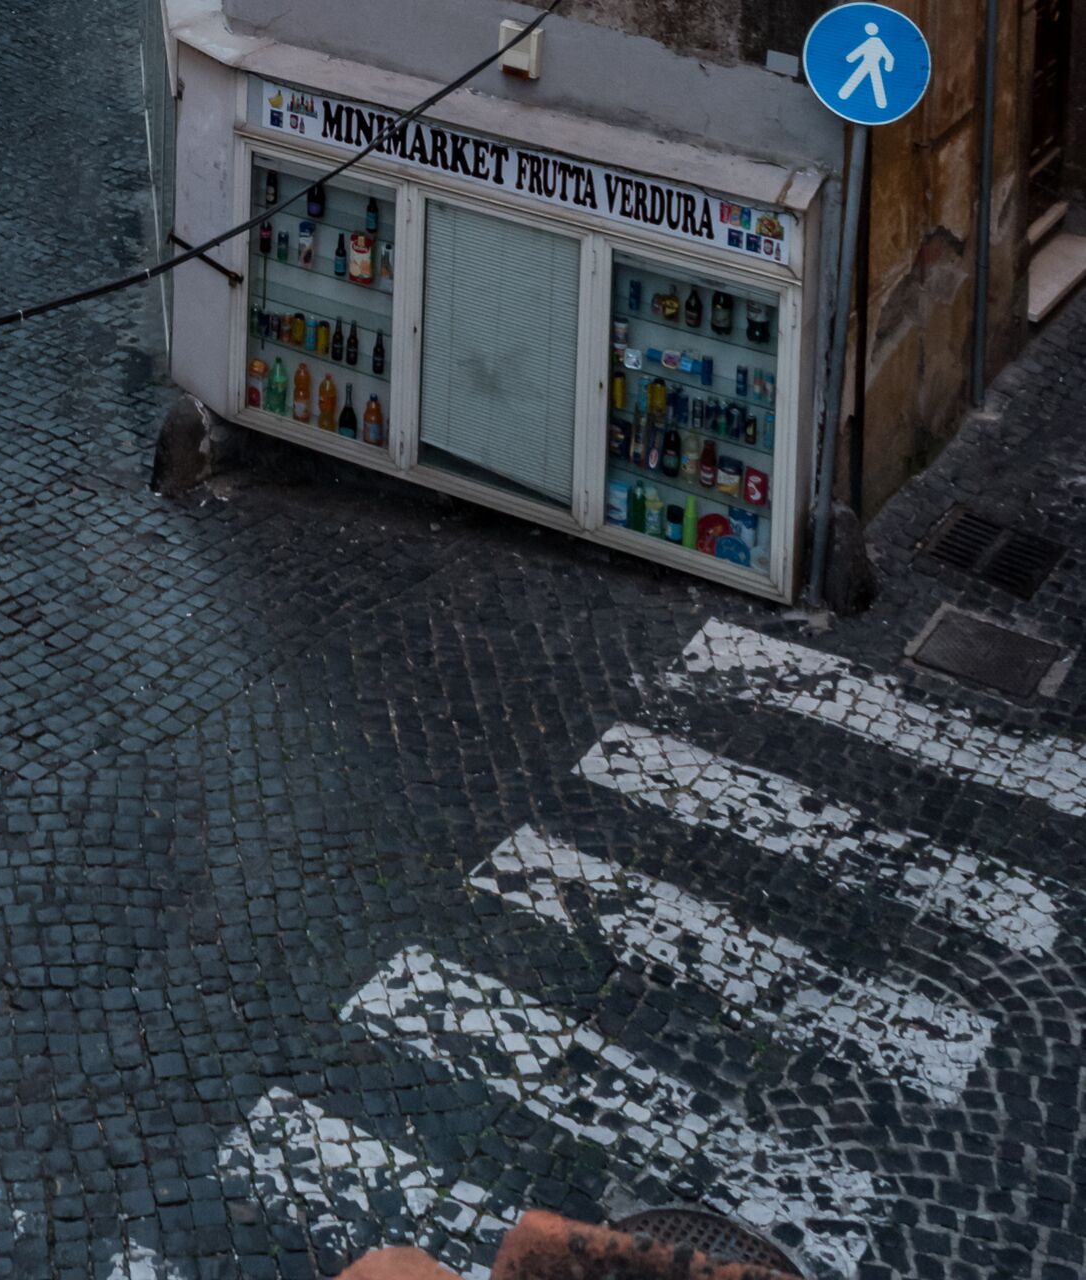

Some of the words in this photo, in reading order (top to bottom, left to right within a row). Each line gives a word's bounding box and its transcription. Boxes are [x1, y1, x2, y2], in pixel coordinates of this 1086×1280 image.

[320, 99, 509, 186] MINIMARKET
[516, 150, 598, 210] FRUTTA
[604, 172, 717, 241] VERDURA
